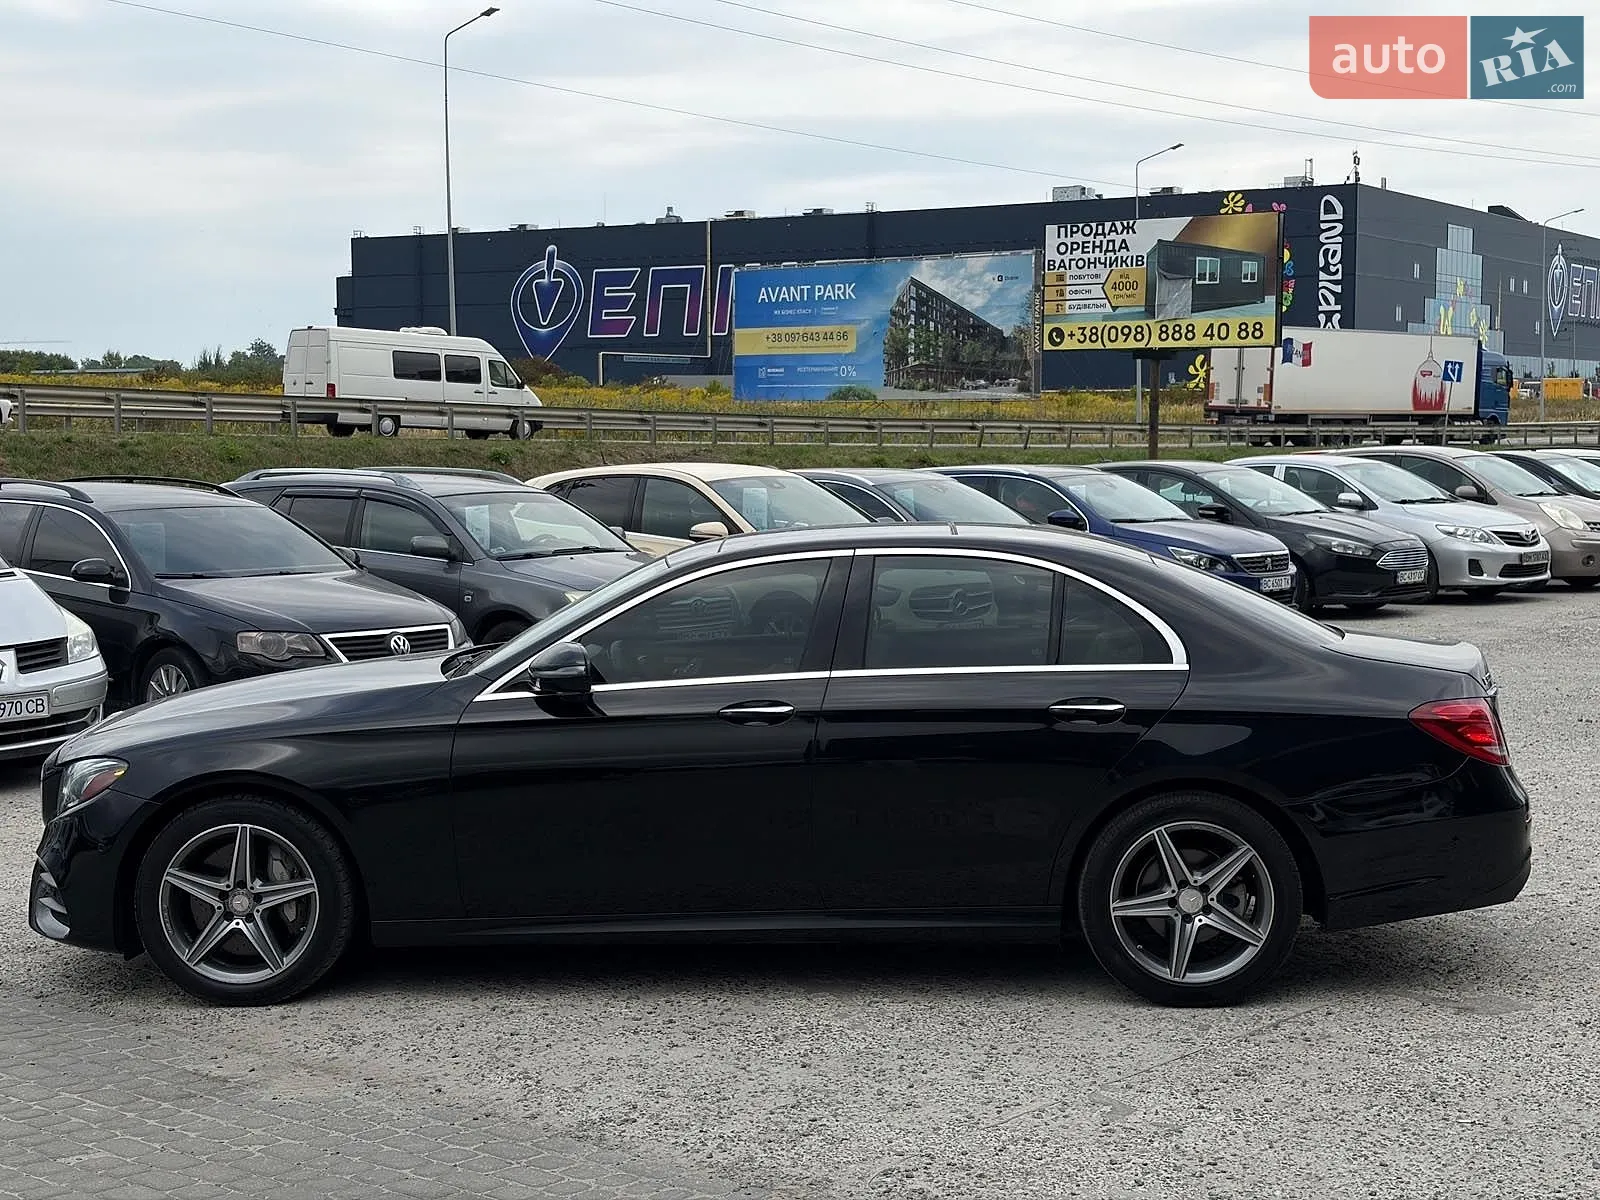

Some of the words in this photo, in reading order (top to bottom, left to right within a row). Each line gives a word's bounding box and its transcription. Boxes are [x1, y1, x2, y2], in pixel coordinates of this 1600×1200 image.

[1057, 221, 1137, 239] ПРОДАЖ
[1057, 239, 1130, 256] ОРЕНДА
[1047, 255, 1145, 271] ВАГОНЧИКІВ
[758, 285, 811, 303] AVANT
[815, 283, 857, 301] PARK
[1111, 280, 1139, 292] 4000
[766, 332, 783, 343] +38
[802, 332, 820, 342] 643
[822, 332, 834, 341] 44
[837, 331, 849, 341] 66
[1068, 323, 1152, 348] +38(098)
[1158, 323, 1196, 342] 888
[1202, 322, 1230, 341] 40
[1237, 321, 1264, 340] 88
[840, 365, 857, 377] 0%
[0, 700, 23, 718] 970
[25, 698, 46, 714] CB
